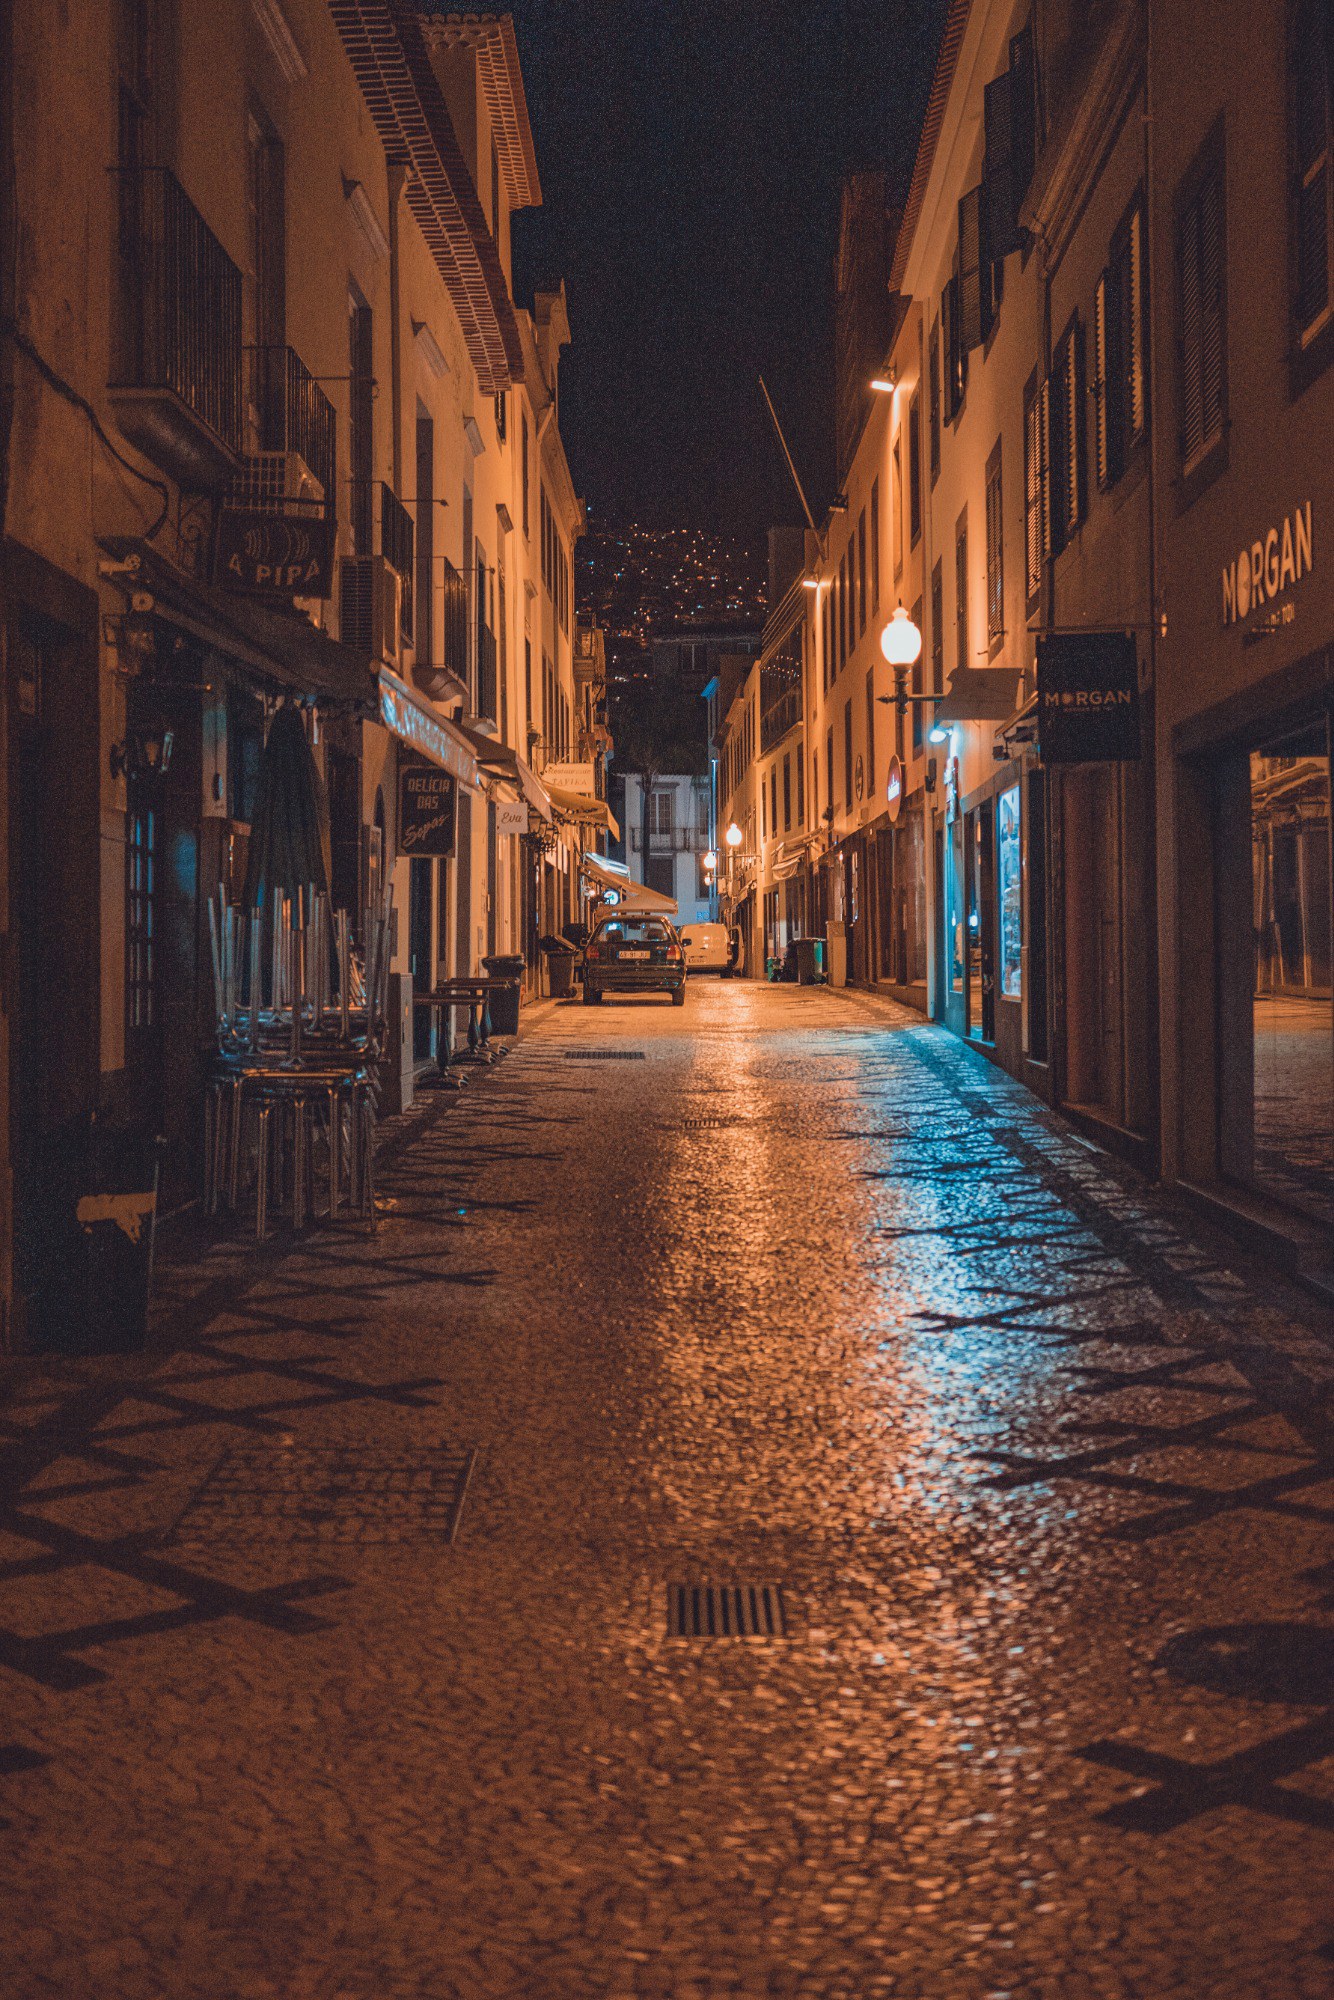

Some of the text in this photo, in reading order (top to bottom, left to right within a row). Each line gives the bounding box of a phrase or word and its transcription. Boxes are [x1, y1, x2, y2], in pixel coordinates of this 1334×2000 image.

[228, 552, 320, 586] A PIPA
[1222, 500, 1313, 625] MORGAN
[1044, 689, 1132, 707] MORGAN
[407, 776, 451, 793] DELÍCIA
[416, 795, 440, 810] DAS
[501, 811, 524, 824] Eva
